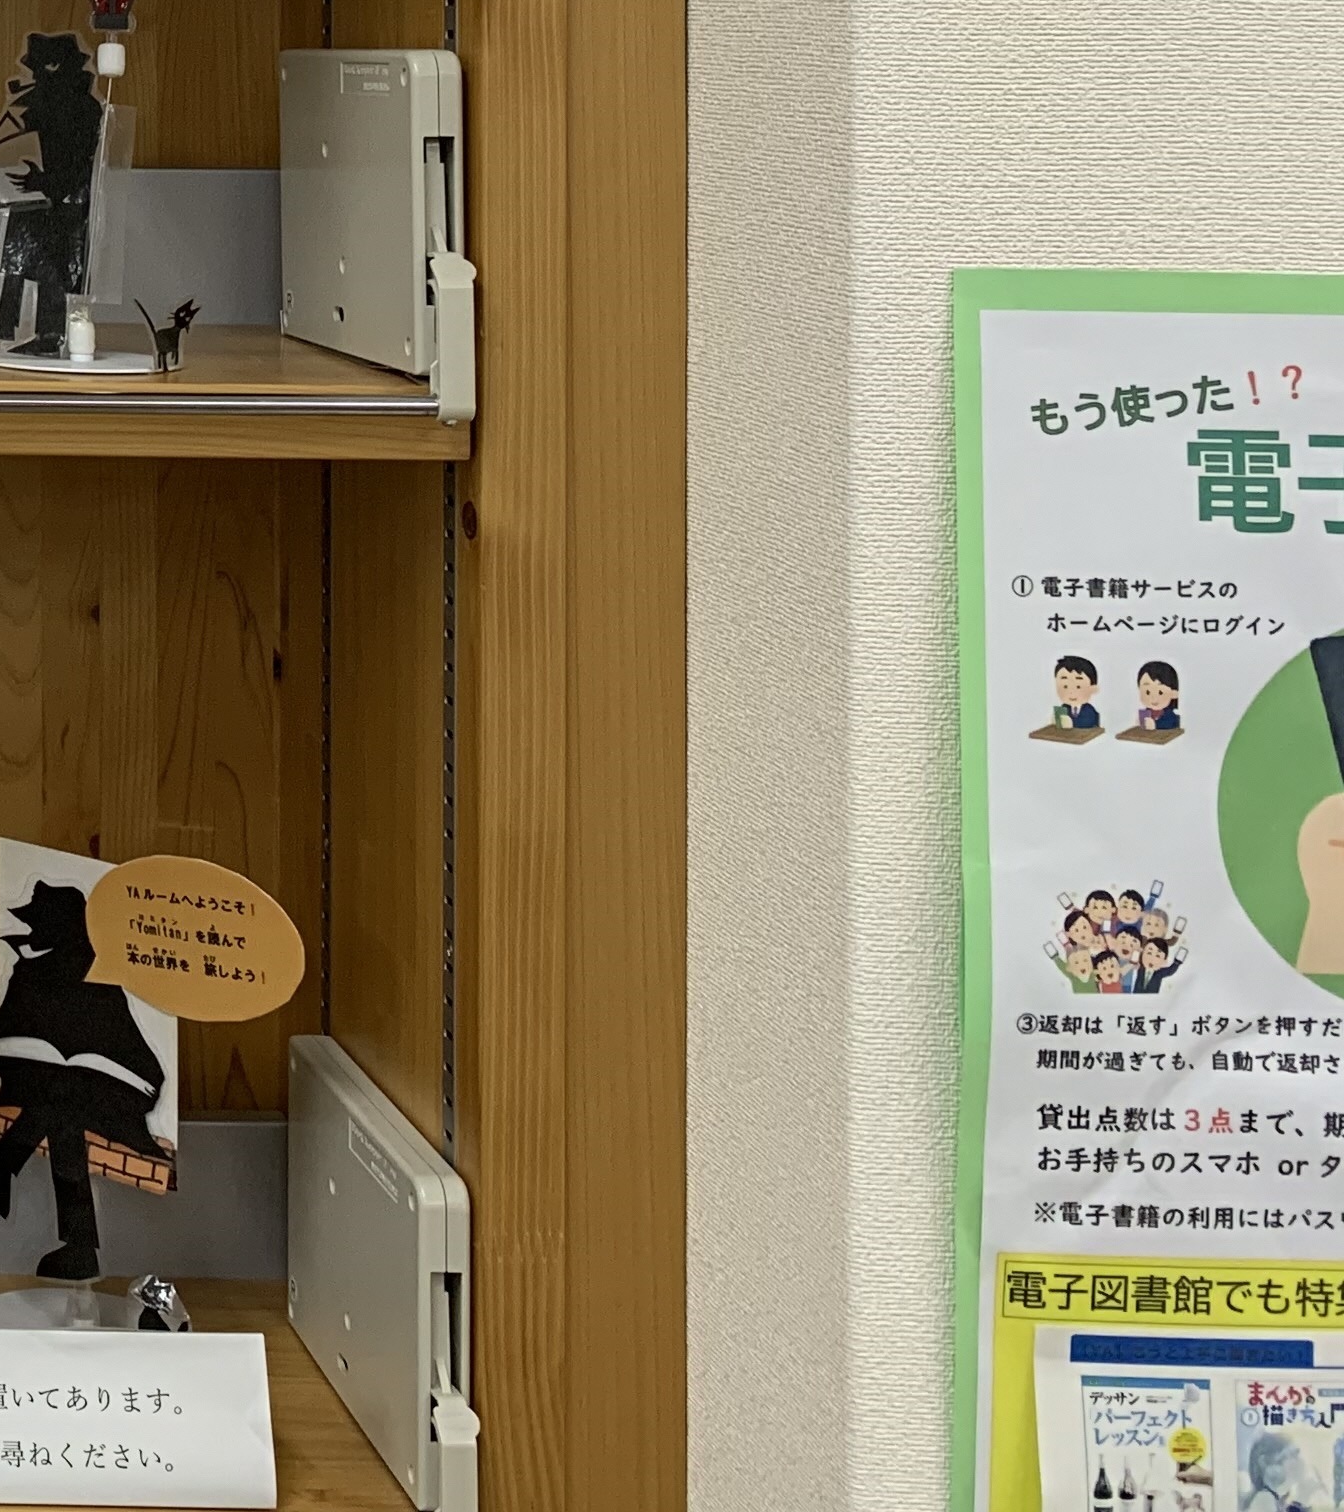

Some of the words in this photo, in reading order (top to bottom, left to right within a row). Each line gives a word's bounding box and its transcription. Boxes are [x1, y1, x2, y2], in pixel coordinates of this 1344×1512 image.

[1047, 613, 1286, 636] ホームページにログイン
[128, 951, 190, 972] 本の世界を
[1036, 1049, 1340, 1074] 期間が過ぎても、自動で返却さ
[1038, 1146, 1261, 1174] お手持ちのスマホ
[1278, 1158, 1309, 1176] or
[1089, 1392, 1140, 1406] デッサン
[1094, 1408, 1192, 1428] パーフェクト
[1094, 1427, 1158, 1446] レッスン
